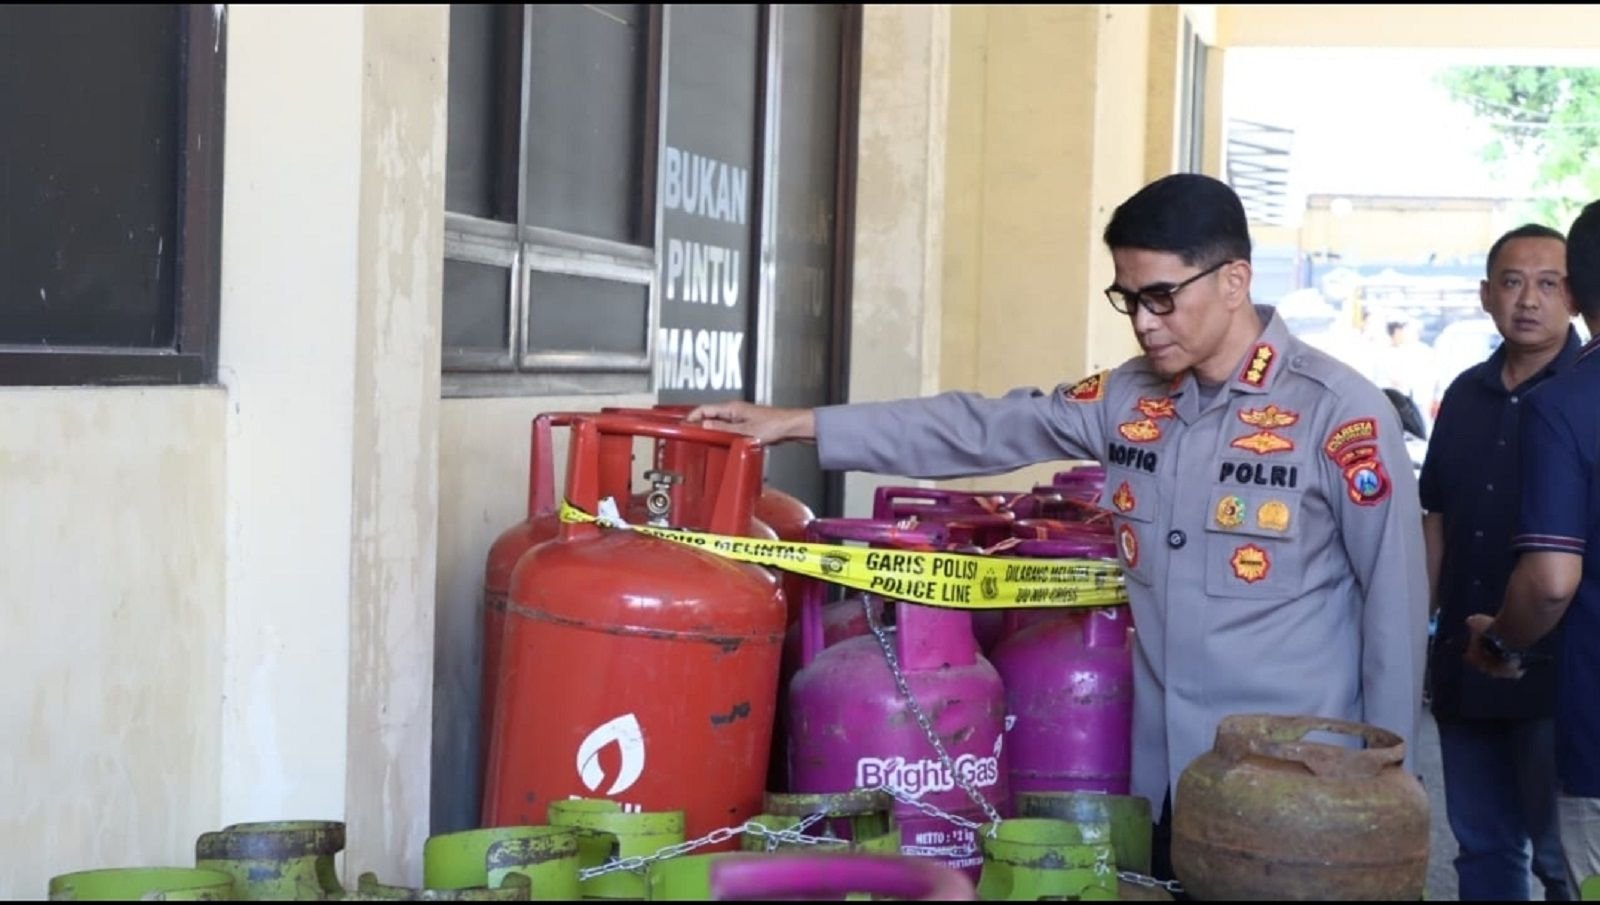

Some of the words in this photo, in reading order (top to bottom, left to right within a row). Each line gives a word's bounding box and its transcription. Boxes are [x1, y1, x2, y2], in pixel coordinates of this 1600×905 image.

[665, 147, 748, 225] BUKAN
[666, 238, 740, 307] PINTU
[657, 327, 744, 391] MASUK
[1219, 461, 1298, 488] POLRI
[714, 541, 808, 562] MELINTAS
[866, 551, 925, 575] GARIS
[932, 557, 978, 581] POLISI
[870, 575, 935, 600] POLICE
[942, 582, 971, 604] LINE
[858, 757, 953, 798] Bright
[955, 754, 998, 787] Gas
[915, 832, 945, 844] NETTO
